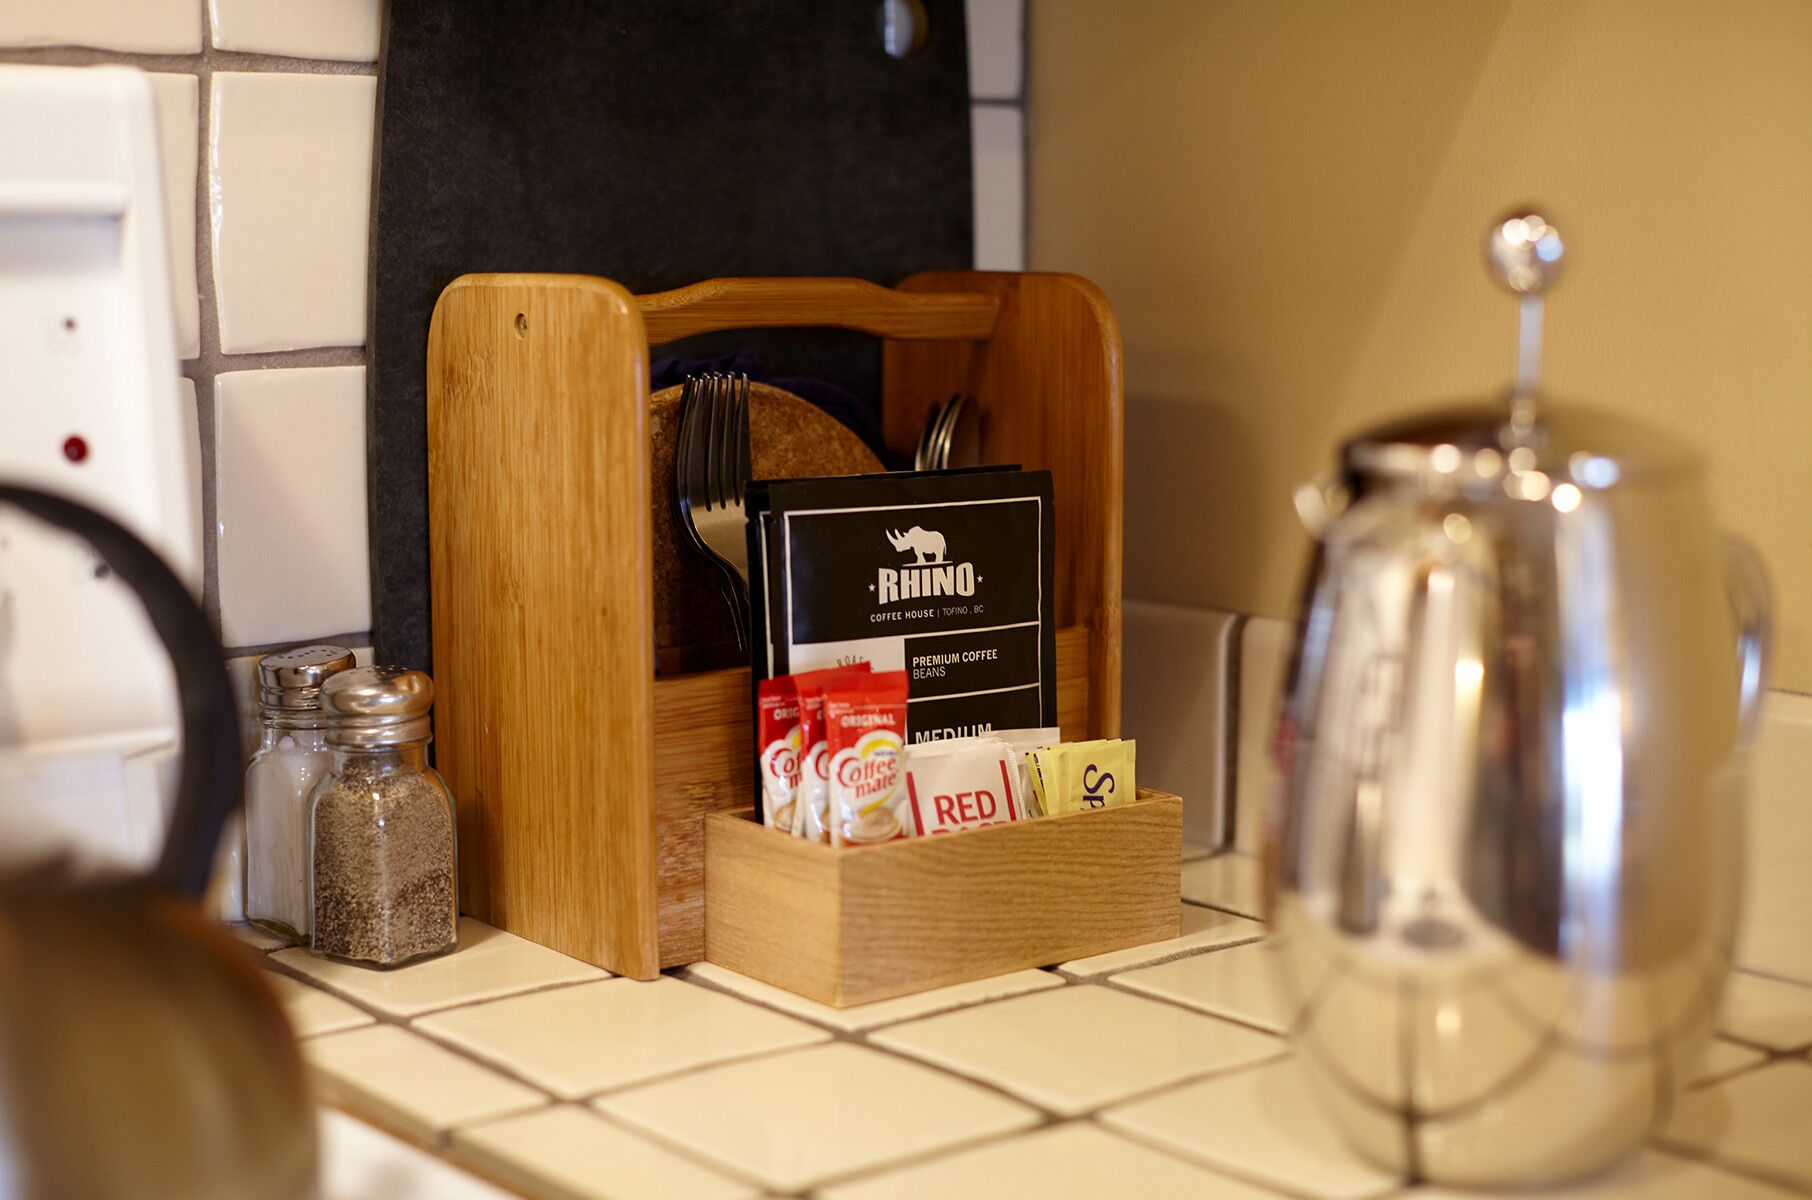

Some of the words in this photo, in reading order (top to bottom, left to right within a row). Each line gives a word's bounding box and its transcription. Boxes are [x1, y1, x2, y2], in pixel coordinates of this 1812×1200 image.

[878, 562, 975, 605] RHINO
[870, 611, 902, 622] COFFEE
[905, 609, 934, 619] HOUSE
[942, 606, 968, 616] TOFINO
[973, 604, 984, 614] BC
[913, 652, 960, 667] PREMIUM
[962, 649, 998, 662] COFFEE
[913, 666, 946, 680] BEANS
[841, 713, 896, 728] ORIGINAL
[838, 756, 897, 788] Coffee
[855, 772, 897, 800] mate
[933, 790, 997, 826] RED
